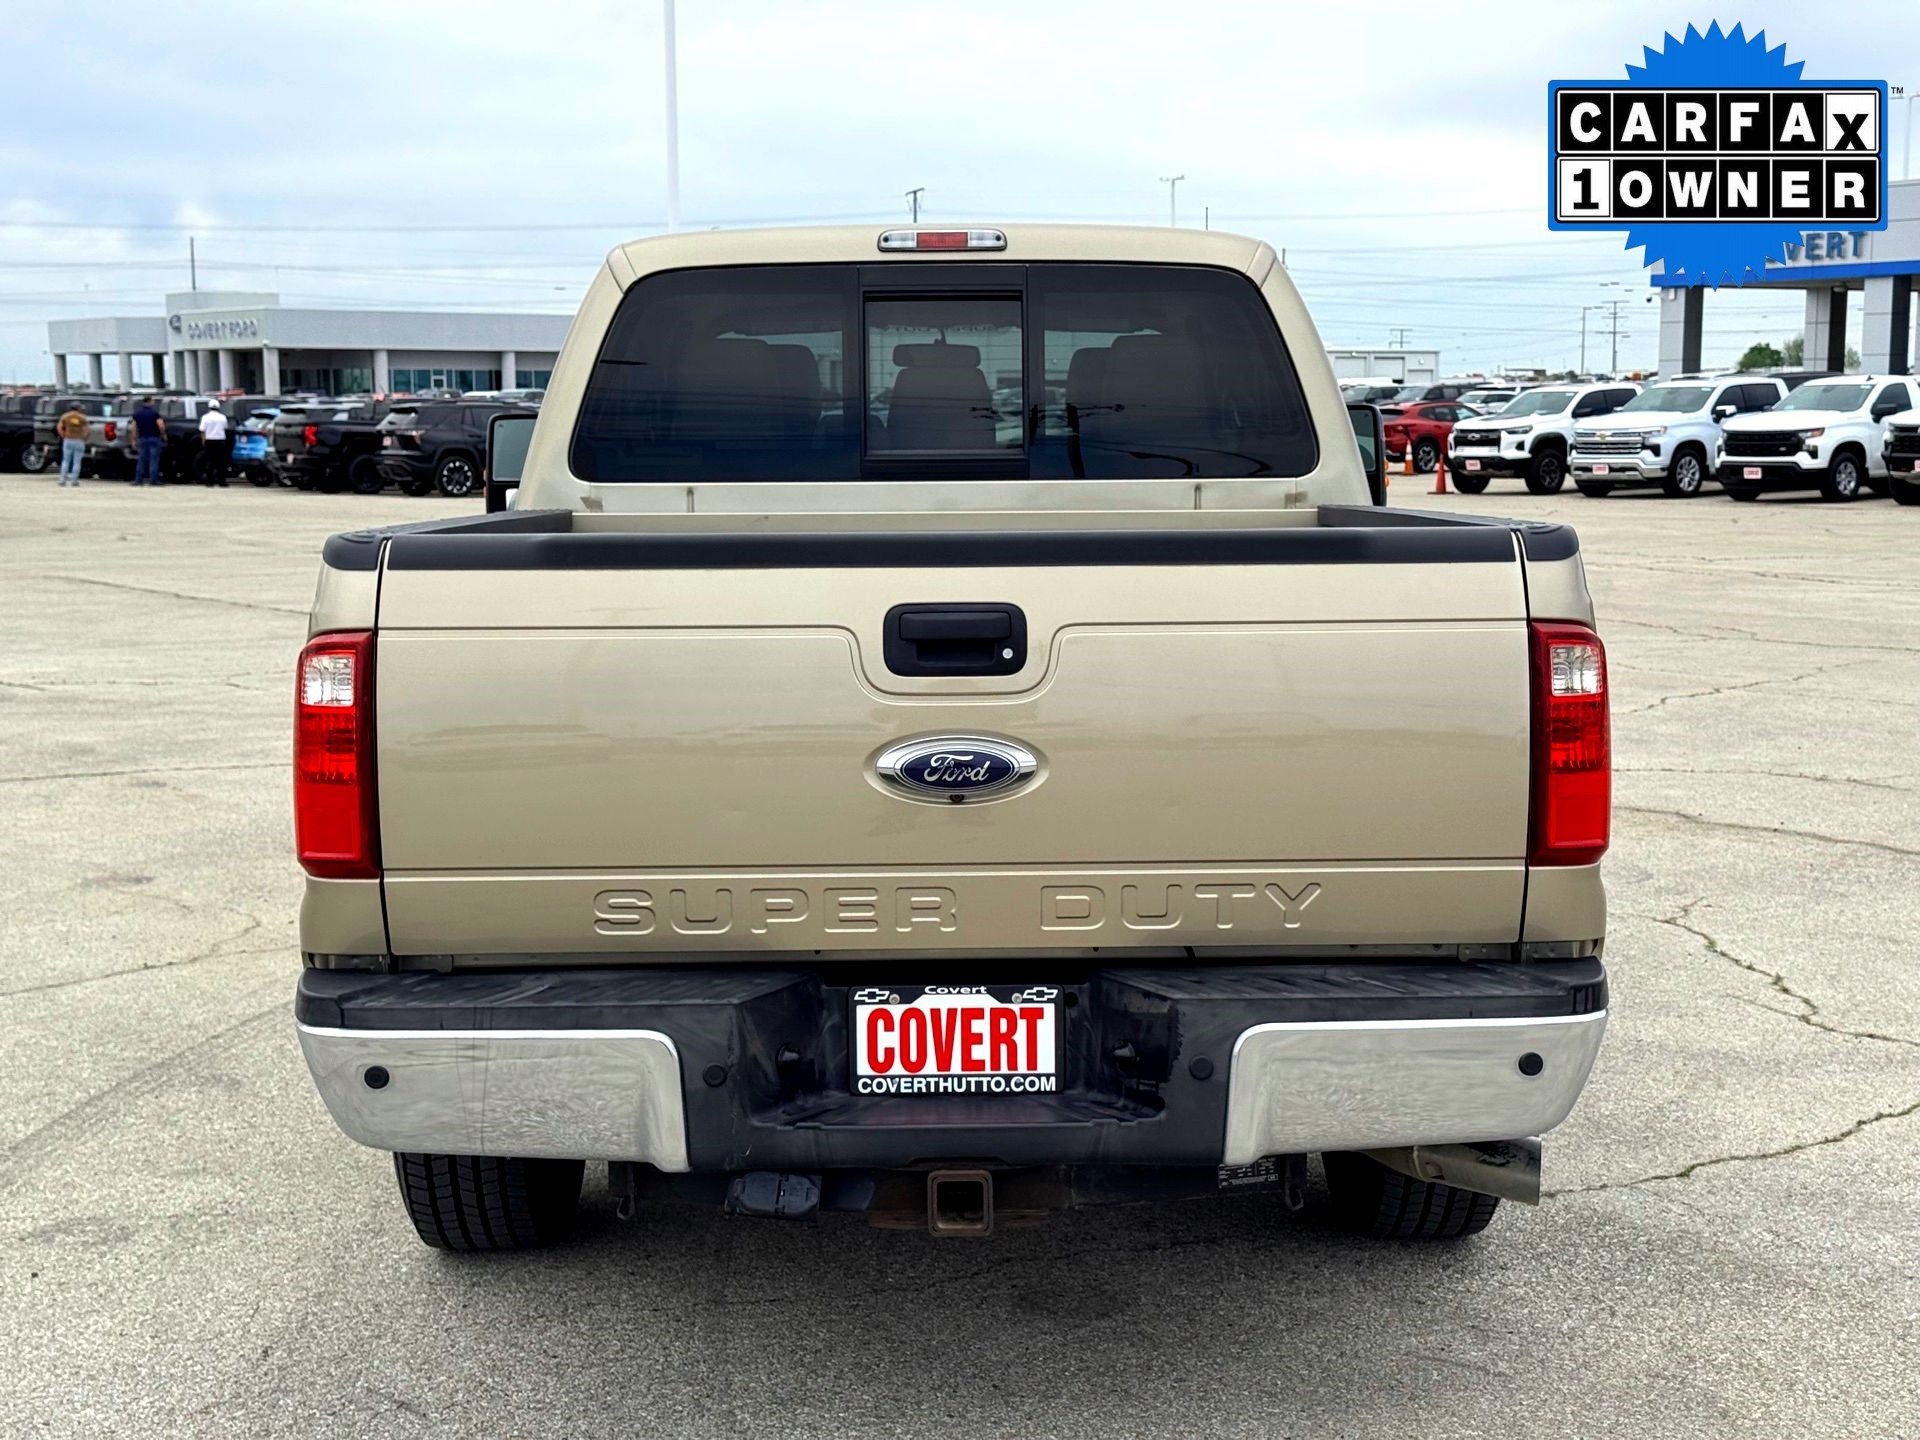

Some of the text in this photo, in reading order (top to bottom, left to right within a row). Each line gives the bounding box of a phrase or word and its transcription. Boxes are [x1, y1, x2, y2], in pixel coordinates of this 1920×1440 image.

[923, 753, 991, 782] Ford
[593, 882, 1322, 935] SUPER DUTY
[924, 985, 987, 995] Covert
[866, 1006, 1045, 1074] COVERT
[857, 1076, 1057, 1094] COVERTHUTTO.COM
